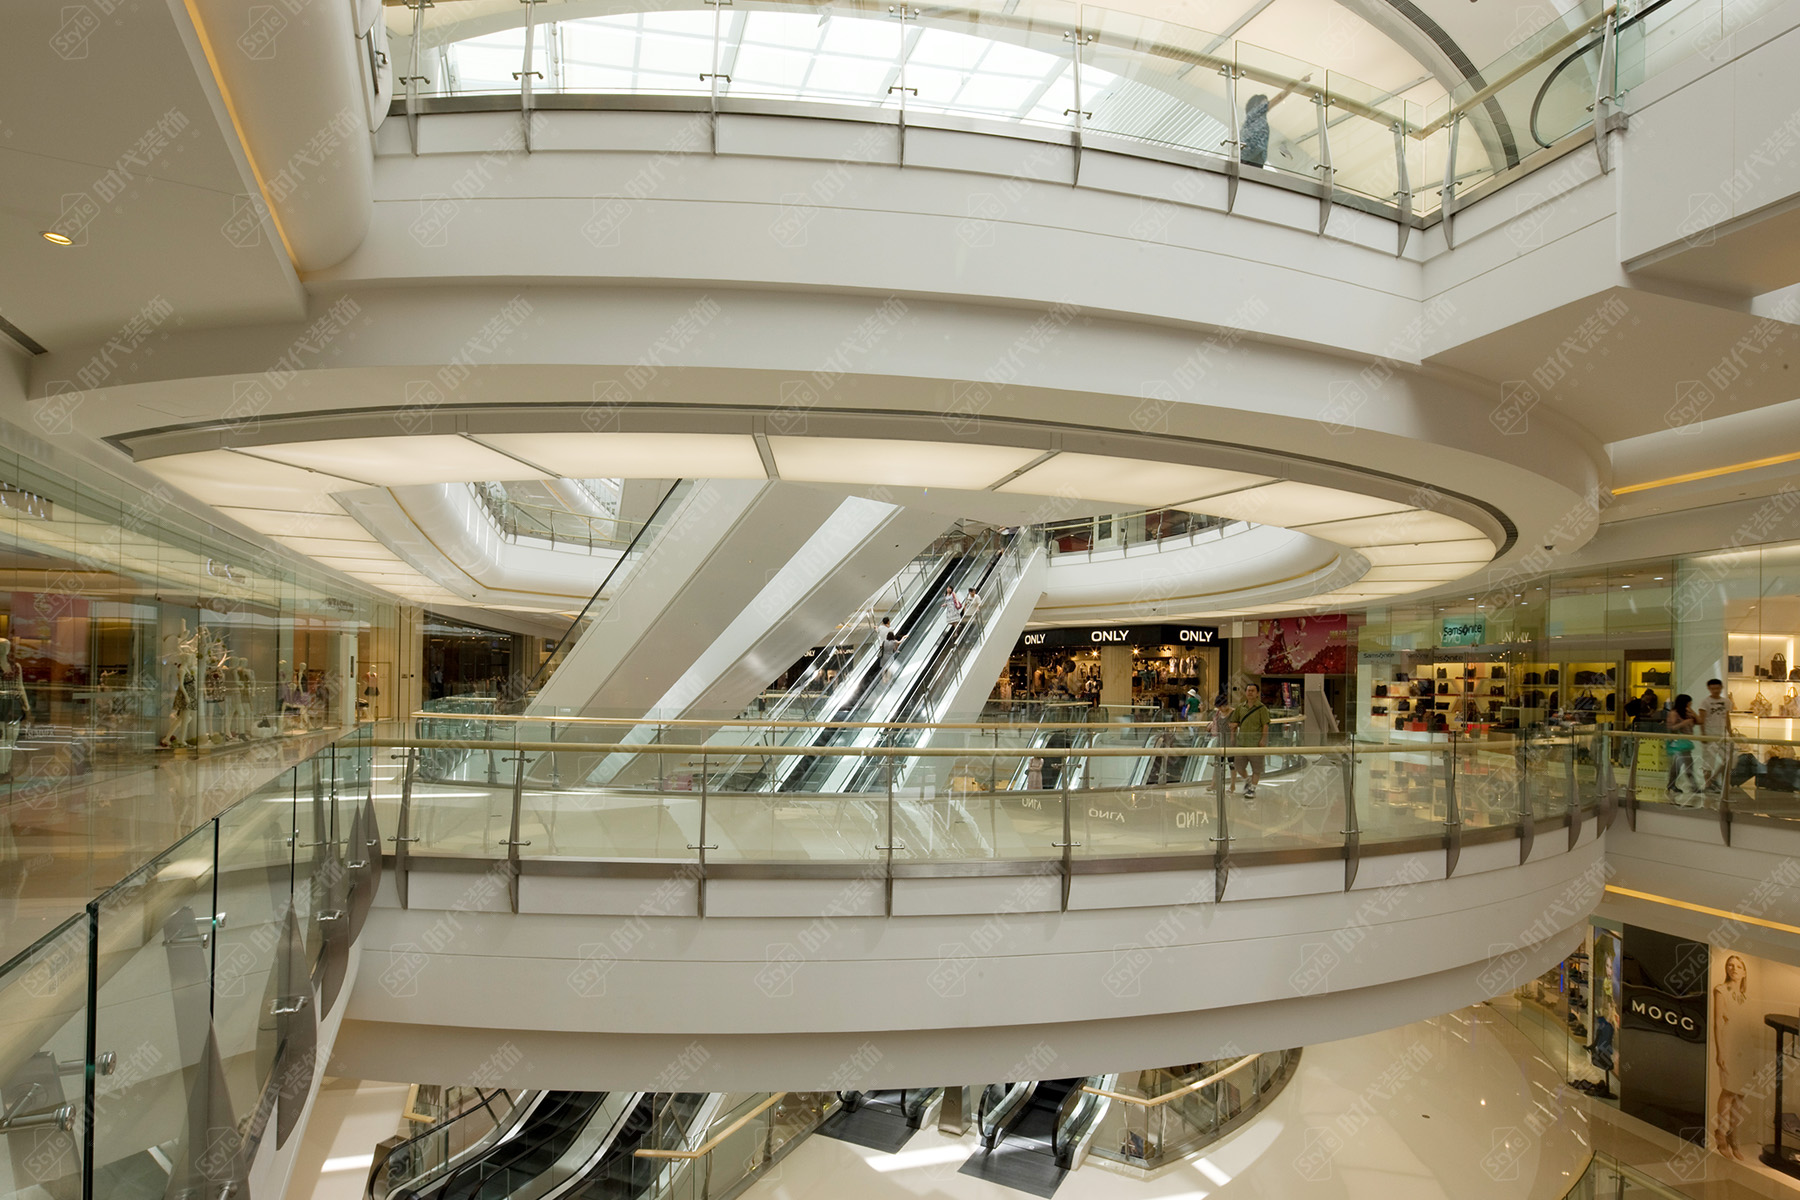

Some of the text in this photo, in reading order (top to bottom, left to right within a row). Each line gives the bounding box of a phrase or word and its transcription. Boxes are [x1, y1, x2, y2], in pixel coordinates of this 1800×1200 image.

[1024, 633, 1046, 645] ONLY
[1091, 629, 1130, 642] ONLY
[1179, 629, 1213, 643] ONLY
[1631, 999, 1695, 1031] MOGG
